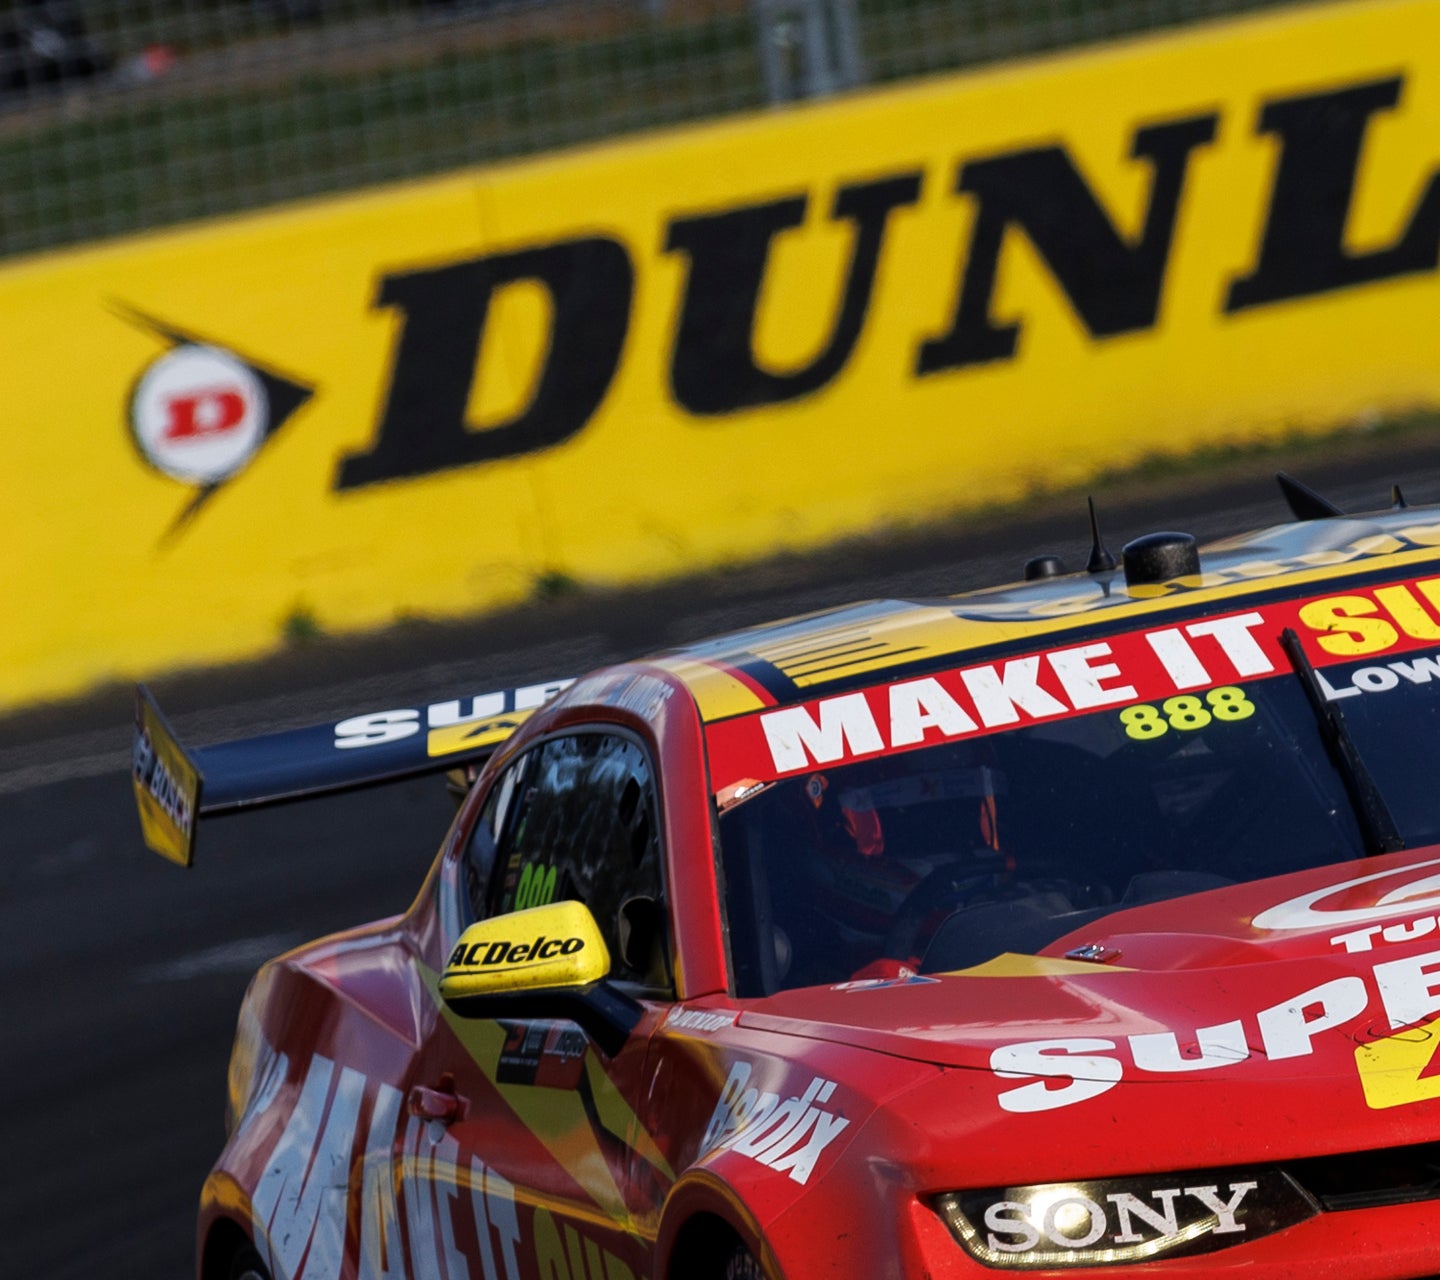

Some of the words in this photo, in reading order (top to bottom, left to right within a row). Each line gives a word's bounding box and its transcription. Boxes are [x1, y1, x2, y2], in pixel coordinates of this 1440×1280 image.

[759, 641, 1139, 774] MAKE
[1143, 612, 1275, 689] IT
[1118, 686, 1257, 742] 888
[447, 935, 586, 968] ACDelco
[696, 1060, 851, 1186] Bendix
[983, 1181, 1259, 1254] SONY
